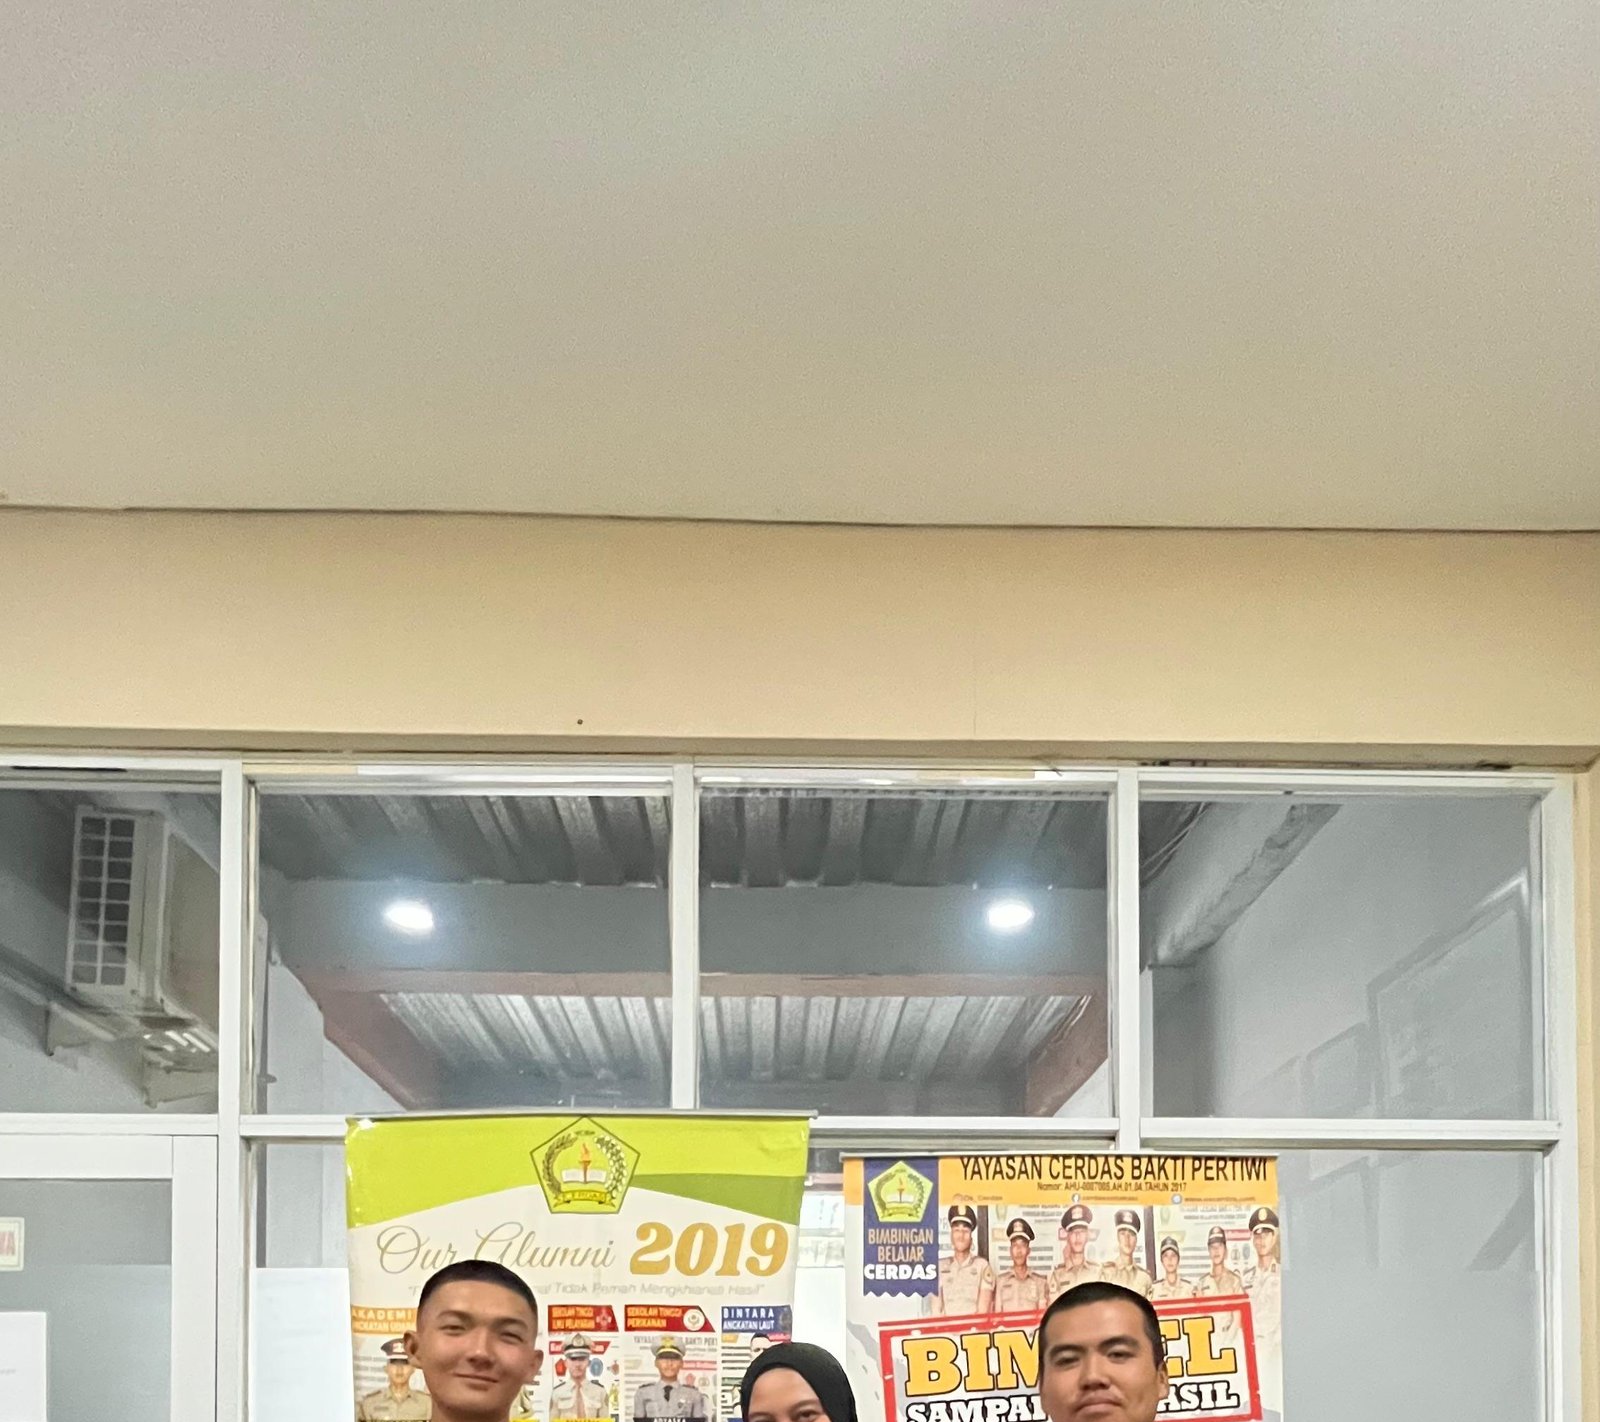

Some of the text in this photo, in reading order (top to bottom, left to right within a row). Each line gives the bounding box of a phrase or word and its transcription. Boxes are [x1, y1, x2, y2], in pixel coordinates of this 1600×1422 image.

[961, 1157, 1267, 1181] YAYASAN CERDAS BAKTI PERTIWI
[868, 1228, 934, 1244] BIMBINGAN
[377, 1221, 789, 1277] Our Alumni 2019
[877, 1246, 924, 1262] BELAJAR
[864, 1263, 937, 1280] CERDAS
[723, 1308, 775, 1319] BINTARA
[723, 1320, 775, 1330] ANGKATAN LAUT
